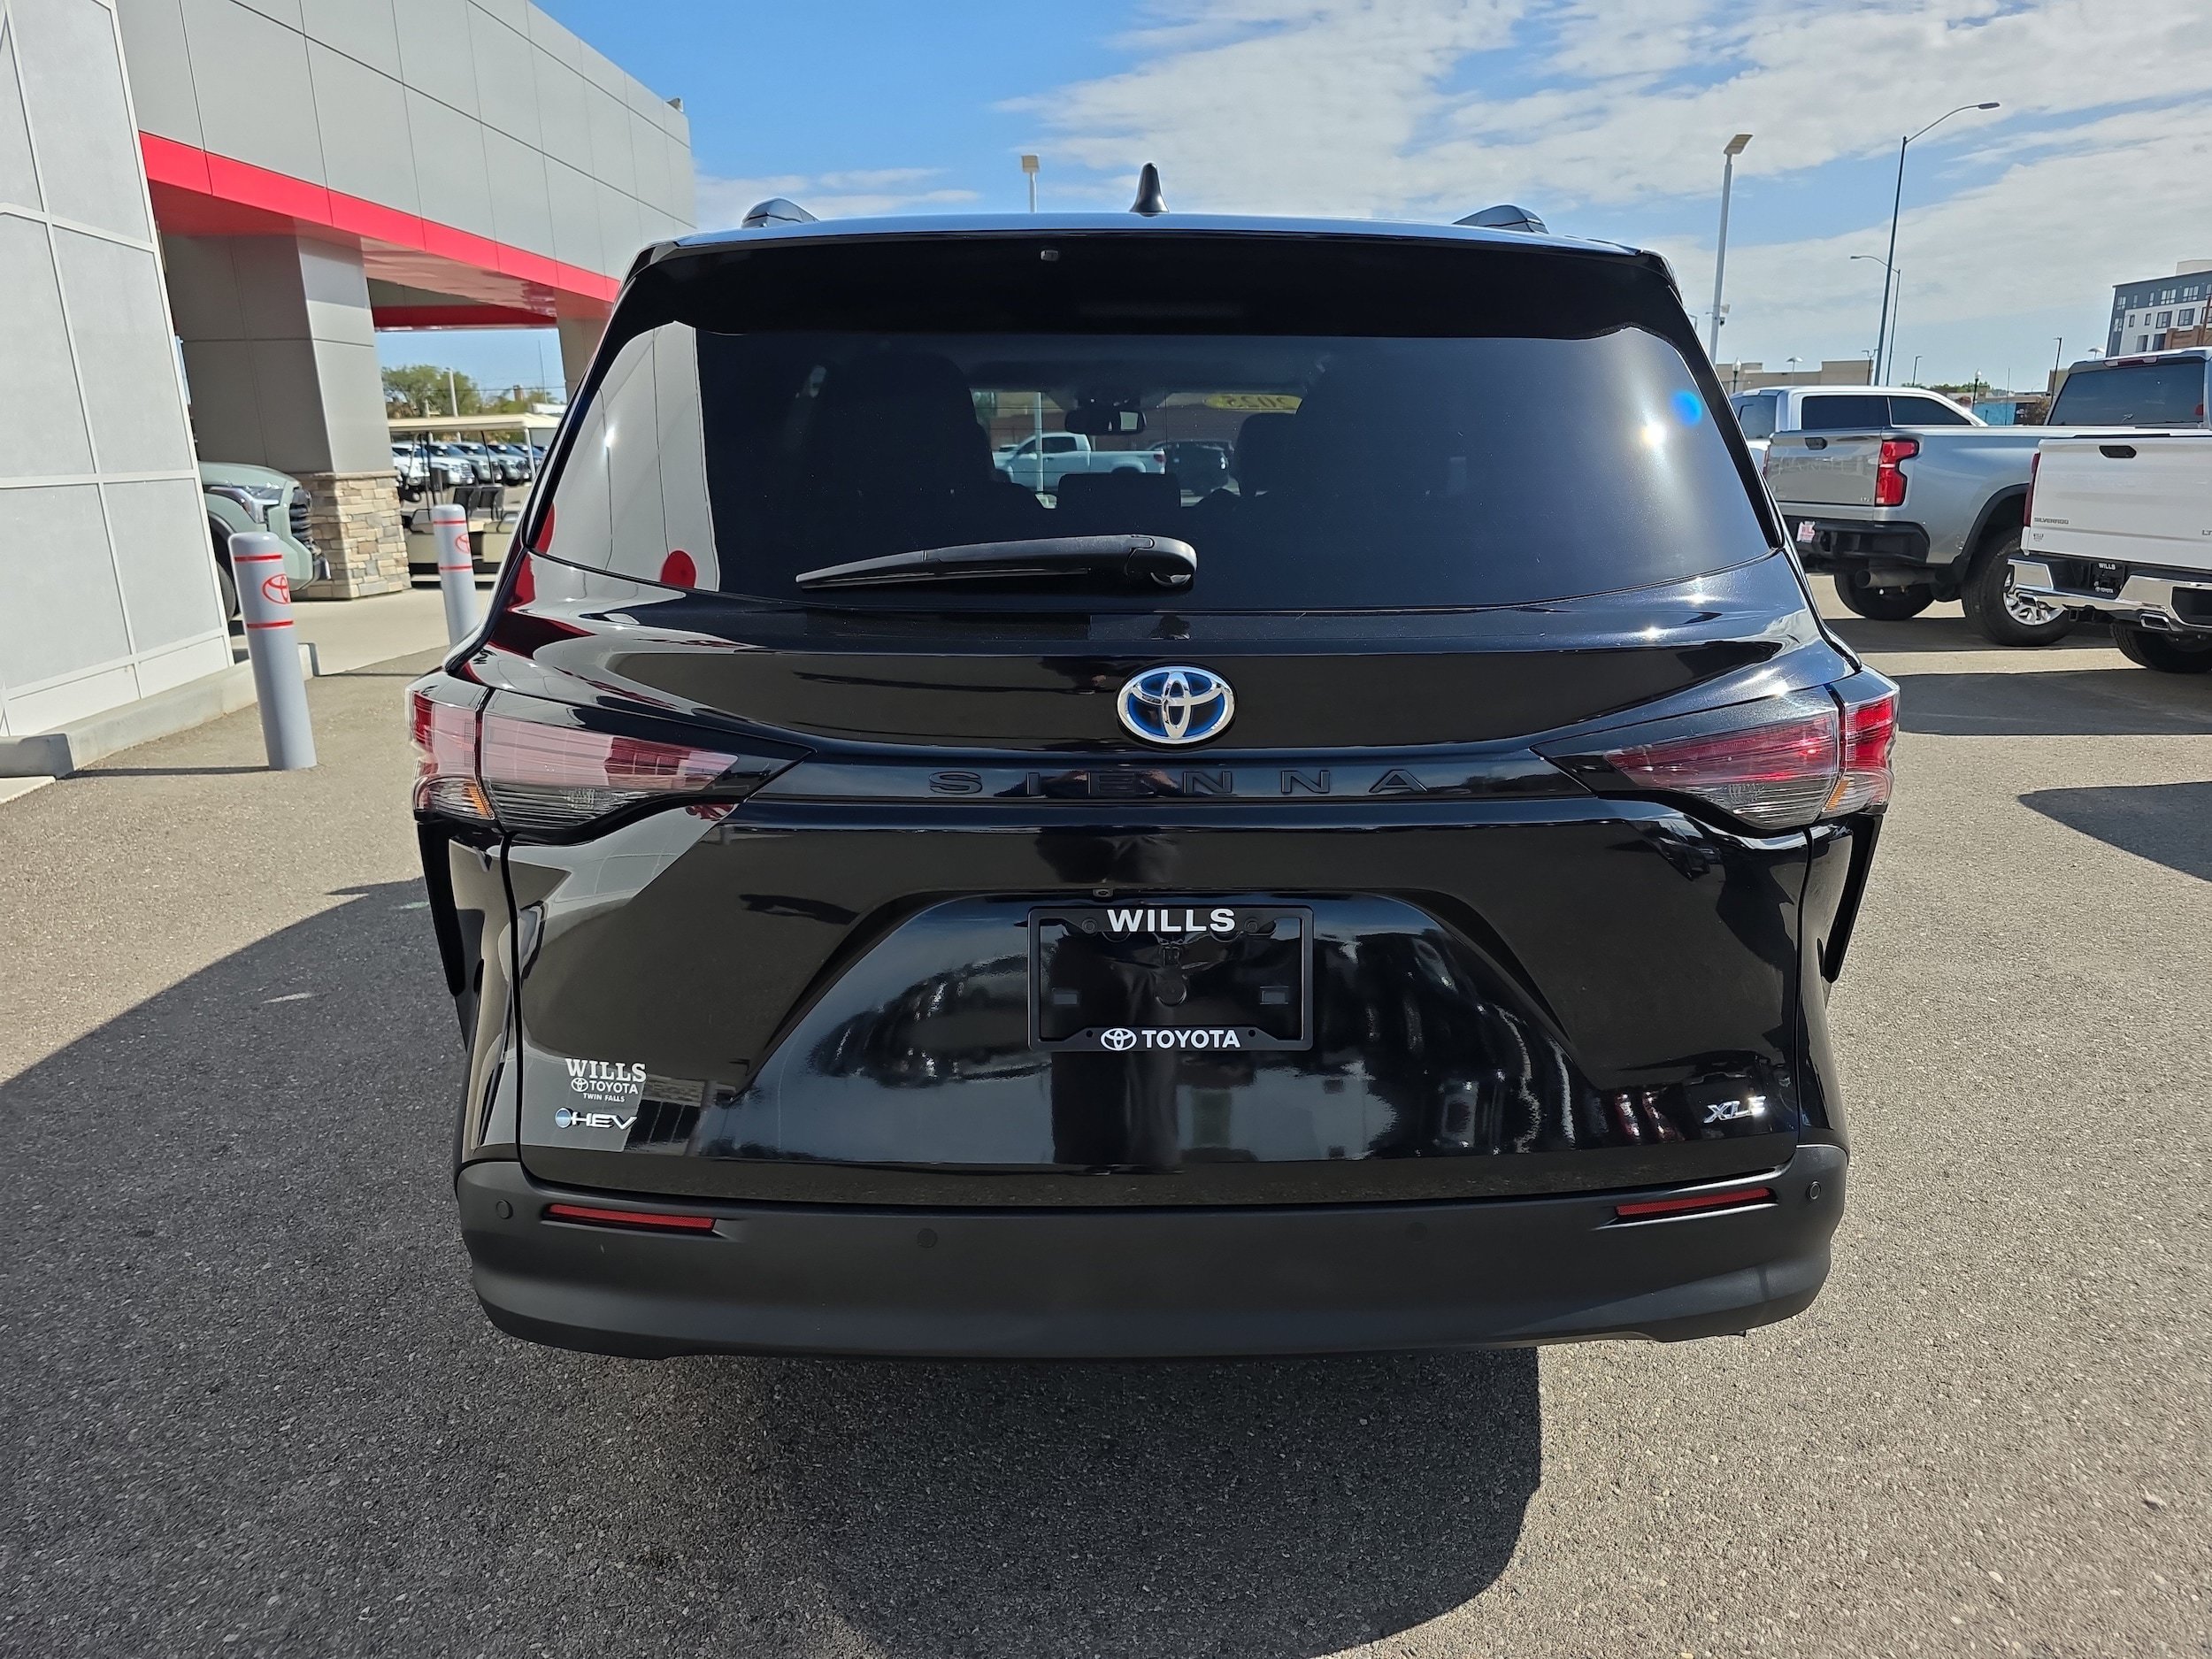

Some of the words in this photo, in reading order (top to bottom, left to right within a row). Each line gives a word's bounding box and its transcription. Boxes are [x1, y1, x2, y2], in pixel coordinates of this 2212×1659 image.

[2098, 562, 2116, 571] WILLS
[928, 769, 1428, 795] SIENNA
[1107, 908, 1236, 933] WILLS
[1141, 1029, 1241, 1048] TOYOTA
[565, 1057, 647, 1083] WILLS
[589, 1079, 639, 1094] TOYOTA
[583, 1092, 603, 1101] TWIN
[1702, 1095, 1767, 1124] XLE
[572, 1111, 638, 1130] HEV
